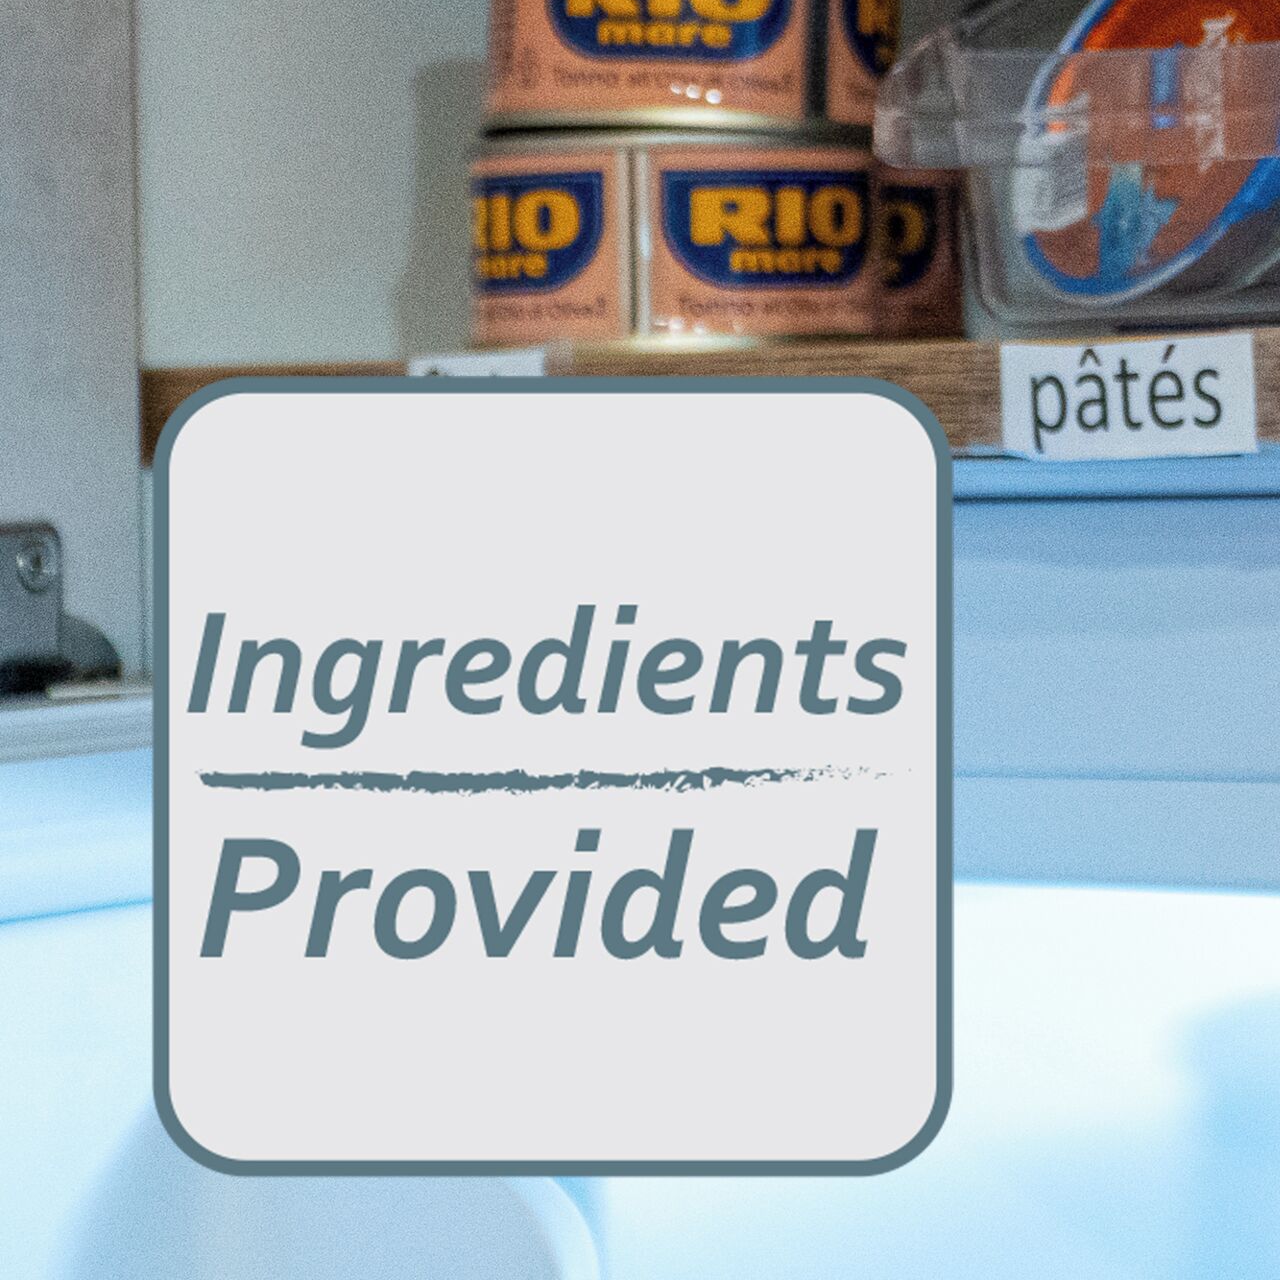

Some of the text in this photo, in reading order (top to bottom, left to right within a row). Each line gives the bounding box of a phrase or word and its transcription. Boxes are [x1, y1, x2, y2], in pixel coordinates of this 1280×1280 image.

[597, 22, 733, 49] mare
[690, 185, 862, 247] RIO
[1030, 343, 1222, 454] pâtés
